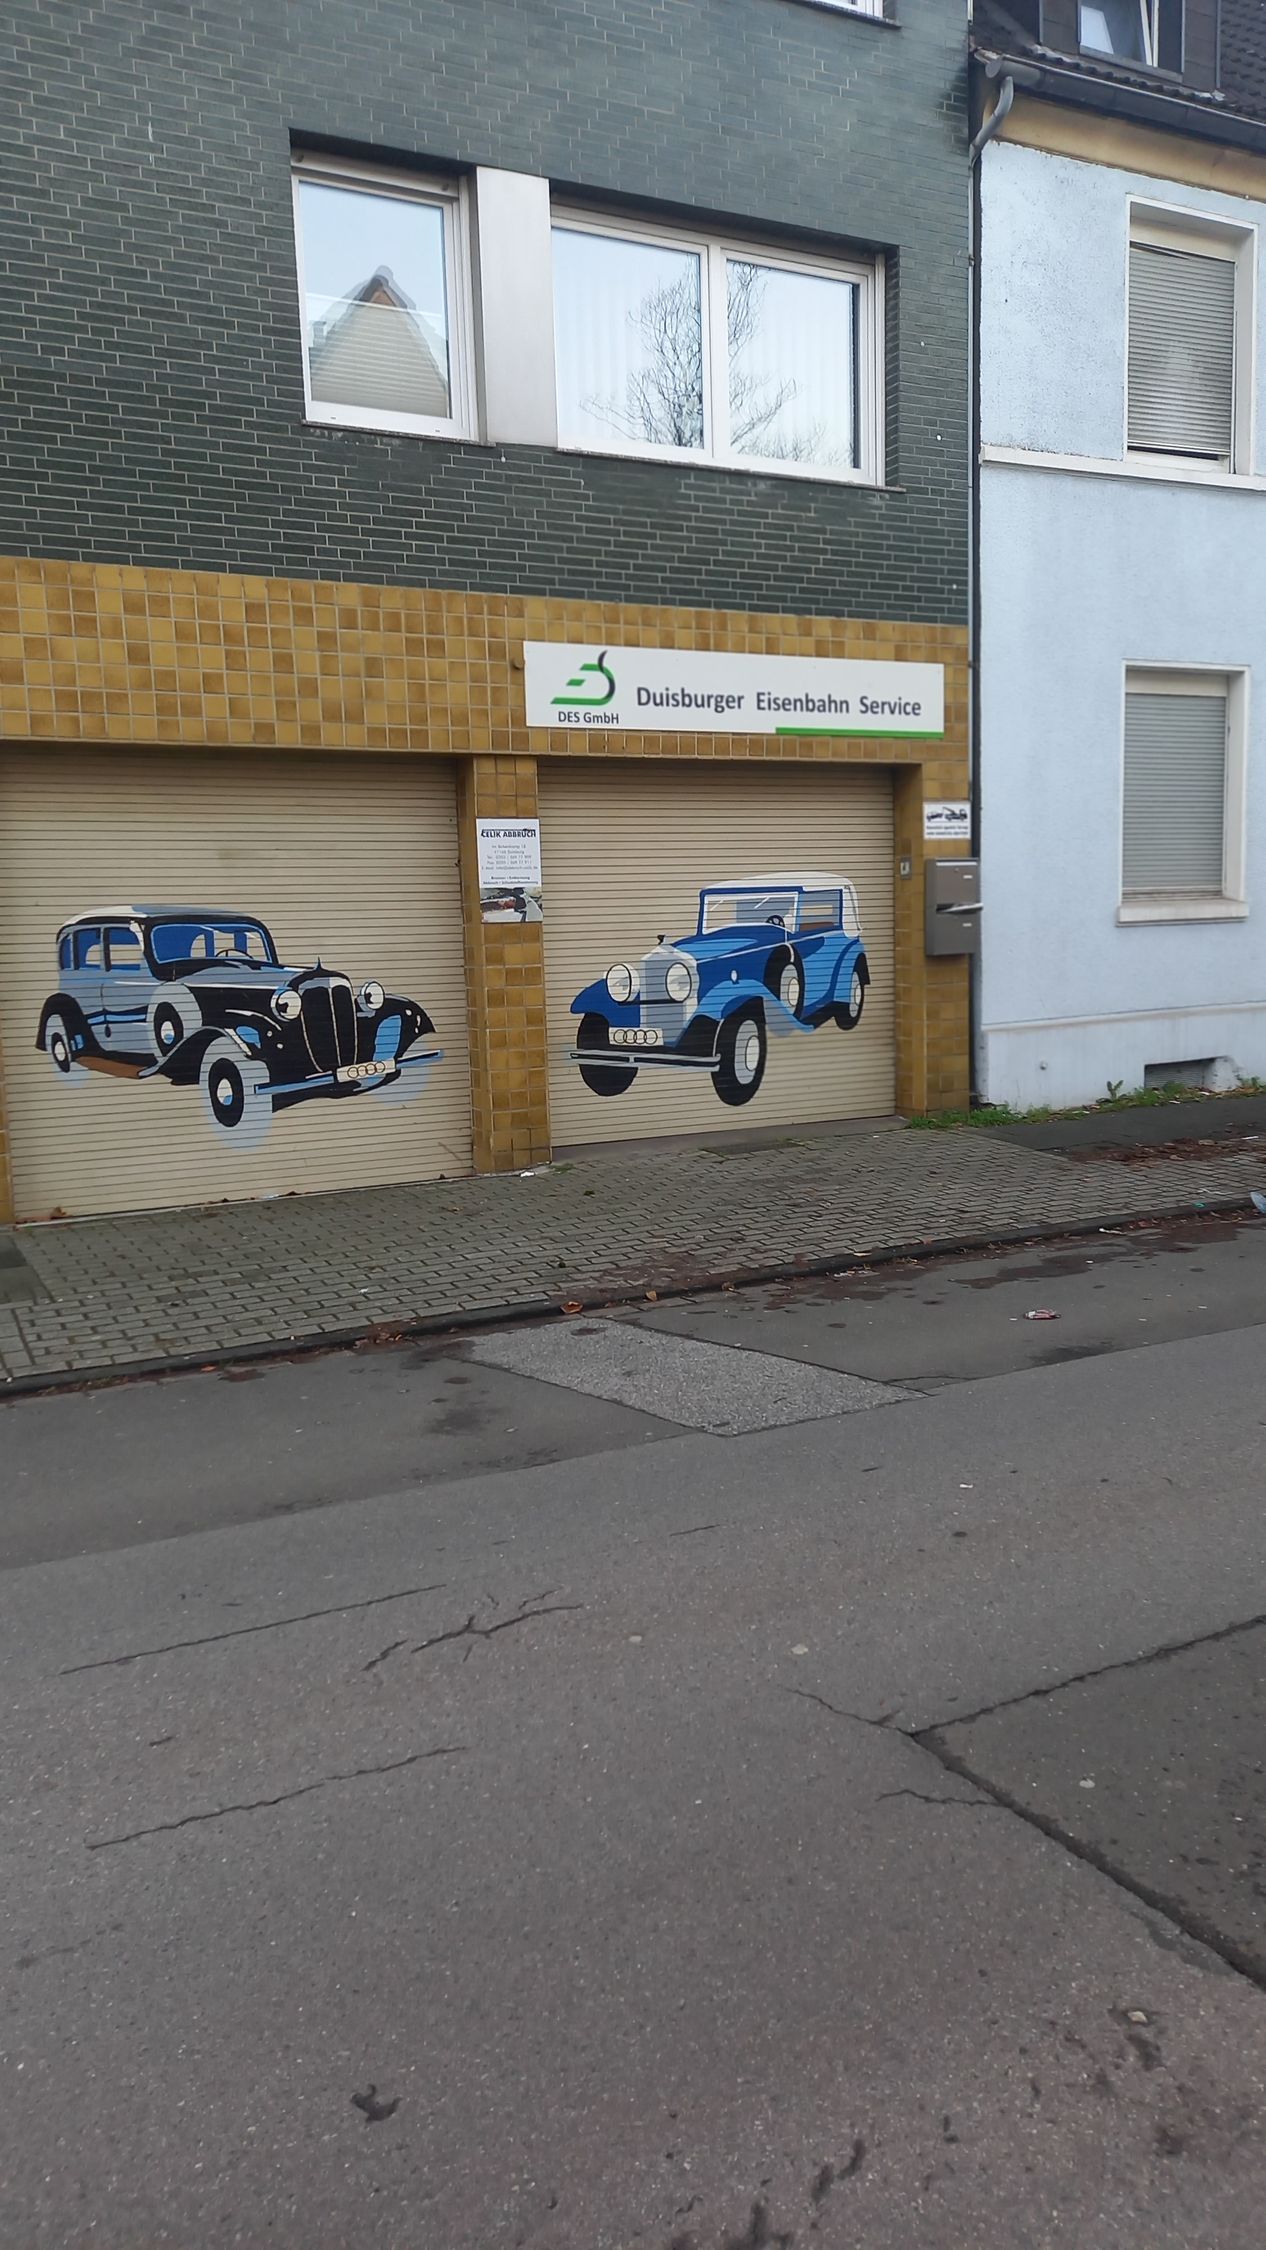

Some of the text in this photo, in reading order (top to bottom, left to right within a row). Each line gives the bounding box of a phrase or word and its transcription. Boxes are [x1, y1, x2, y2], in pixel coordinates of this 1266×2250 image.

[636, 686, 922, 717] Duisburger Eisenbahn Service
[557, 711, 620, 725] DES GmbH
[502, 828, 537, 838] ABBRUCH
